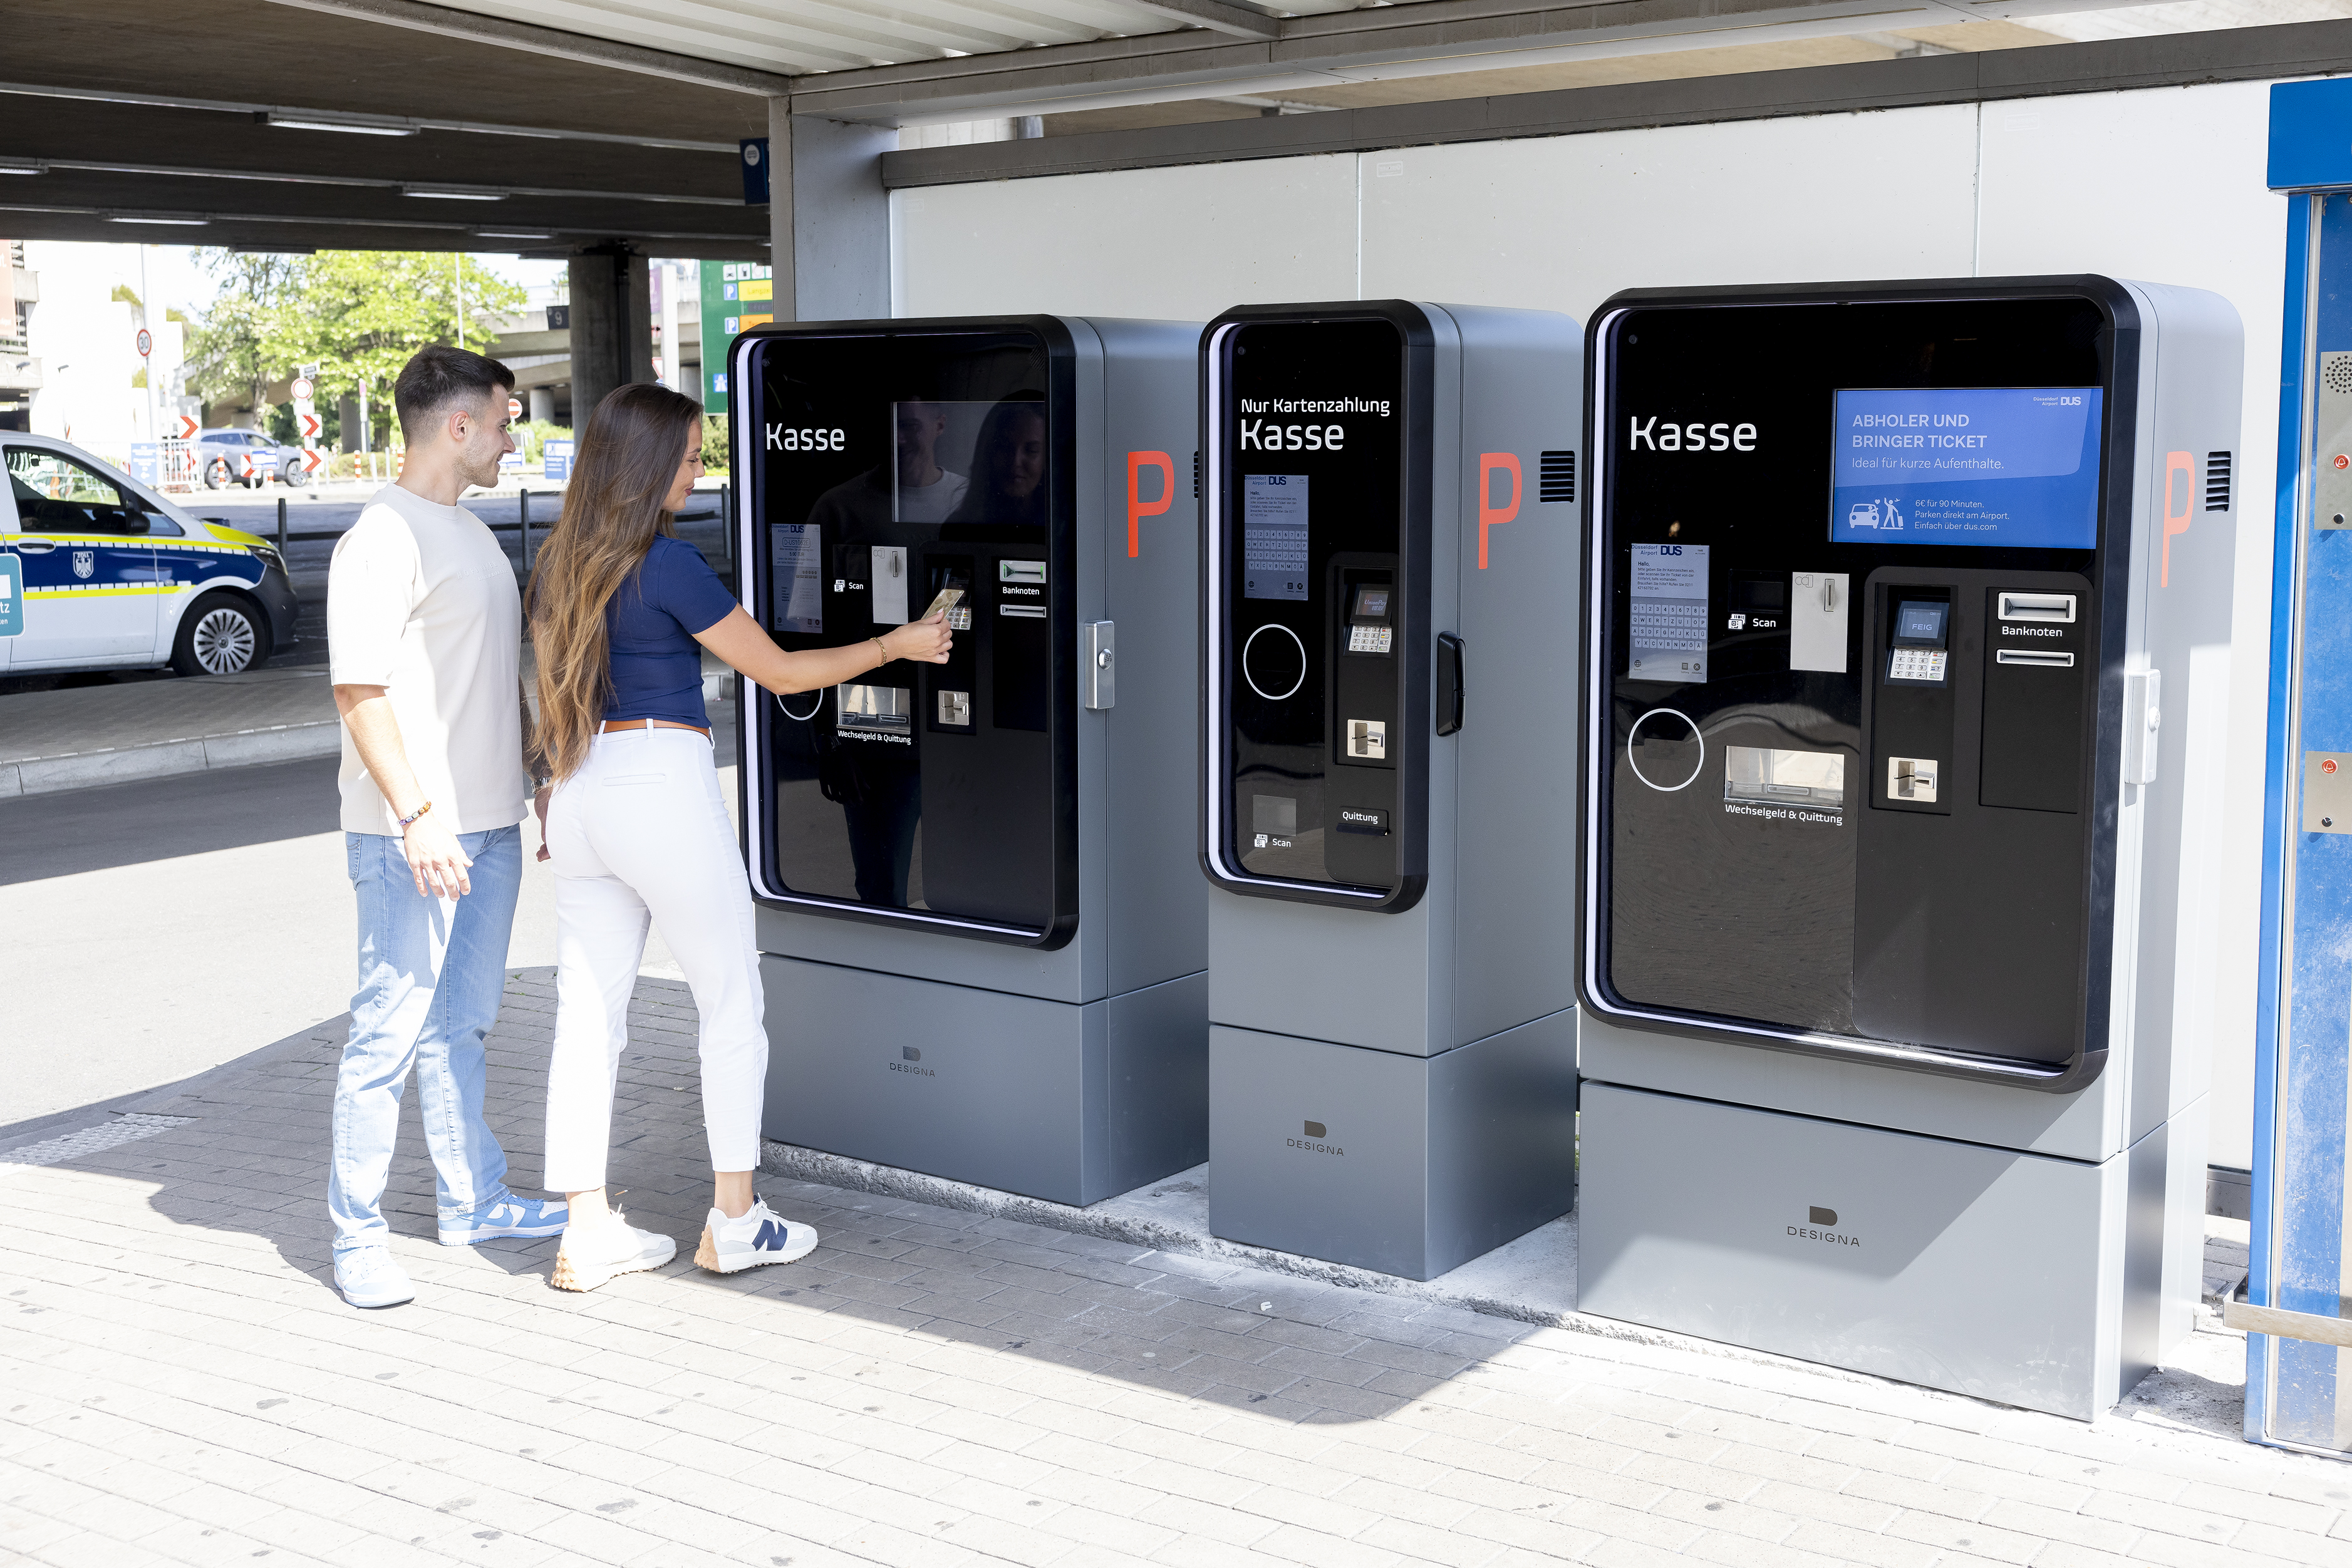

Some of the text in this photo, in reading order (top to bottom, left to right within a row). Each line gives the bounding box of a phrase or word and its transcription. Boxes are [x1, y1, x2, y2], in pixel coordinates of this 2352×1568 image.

[555, 312, 562, 326] 9
[139, 336, 149, 349] 30
[1241, 397, 1390, 417] Nur Kartenzahlung
[2061, 396, 2081, 406] DUS
[1852, 414, 1969, 427] ABHOLER UND
[767, 423, 845, 451] Kasse
[1241, 419, 1344, 450] Kasse
[1630, 416, 1757, 451] Kasse
[1852, 435, 1987, 448] BRINGER TICKET
[1852, 457, 2004, 469] Ideal für kurze Aufenthalte.
[1268, 476, 1287, 485] DUS
[1129, 451, 1174, 558] P
[1951, 500, 1984, 508] Minuten.
[1478, 452, 1522, 570] P
[1980, 512, 2009, 520] Airport.
[1964, 522, 1997, 530] dus.com
[2161, 451, 2196, 589] P
[790, 525, 804, 533] DUS
[1660, 545, 1682, 555] DUS
[849, 582, 864, 590] Scan
[1002, 586, 1040, 595] Banknoten
[1753, 618, 1776, 627] Scan
[2002, 626, 2063, 637] Banknoten
[837, 730, 876, 741] Wechselgeld
[883, 735, 911, 745] Quittung
[1342, 811, 1378, 825] Quittung
[1725, 804, 1843, 826] Wechselgeld & Quittung
[1272, 838, 1292, 848] Scan
[889, 1063, 935, 1078] DESIGNA
[1287, 1138, 1344, 1157] DESIGNA
[1787, 1226, 1860, 1247] DESIGNA
